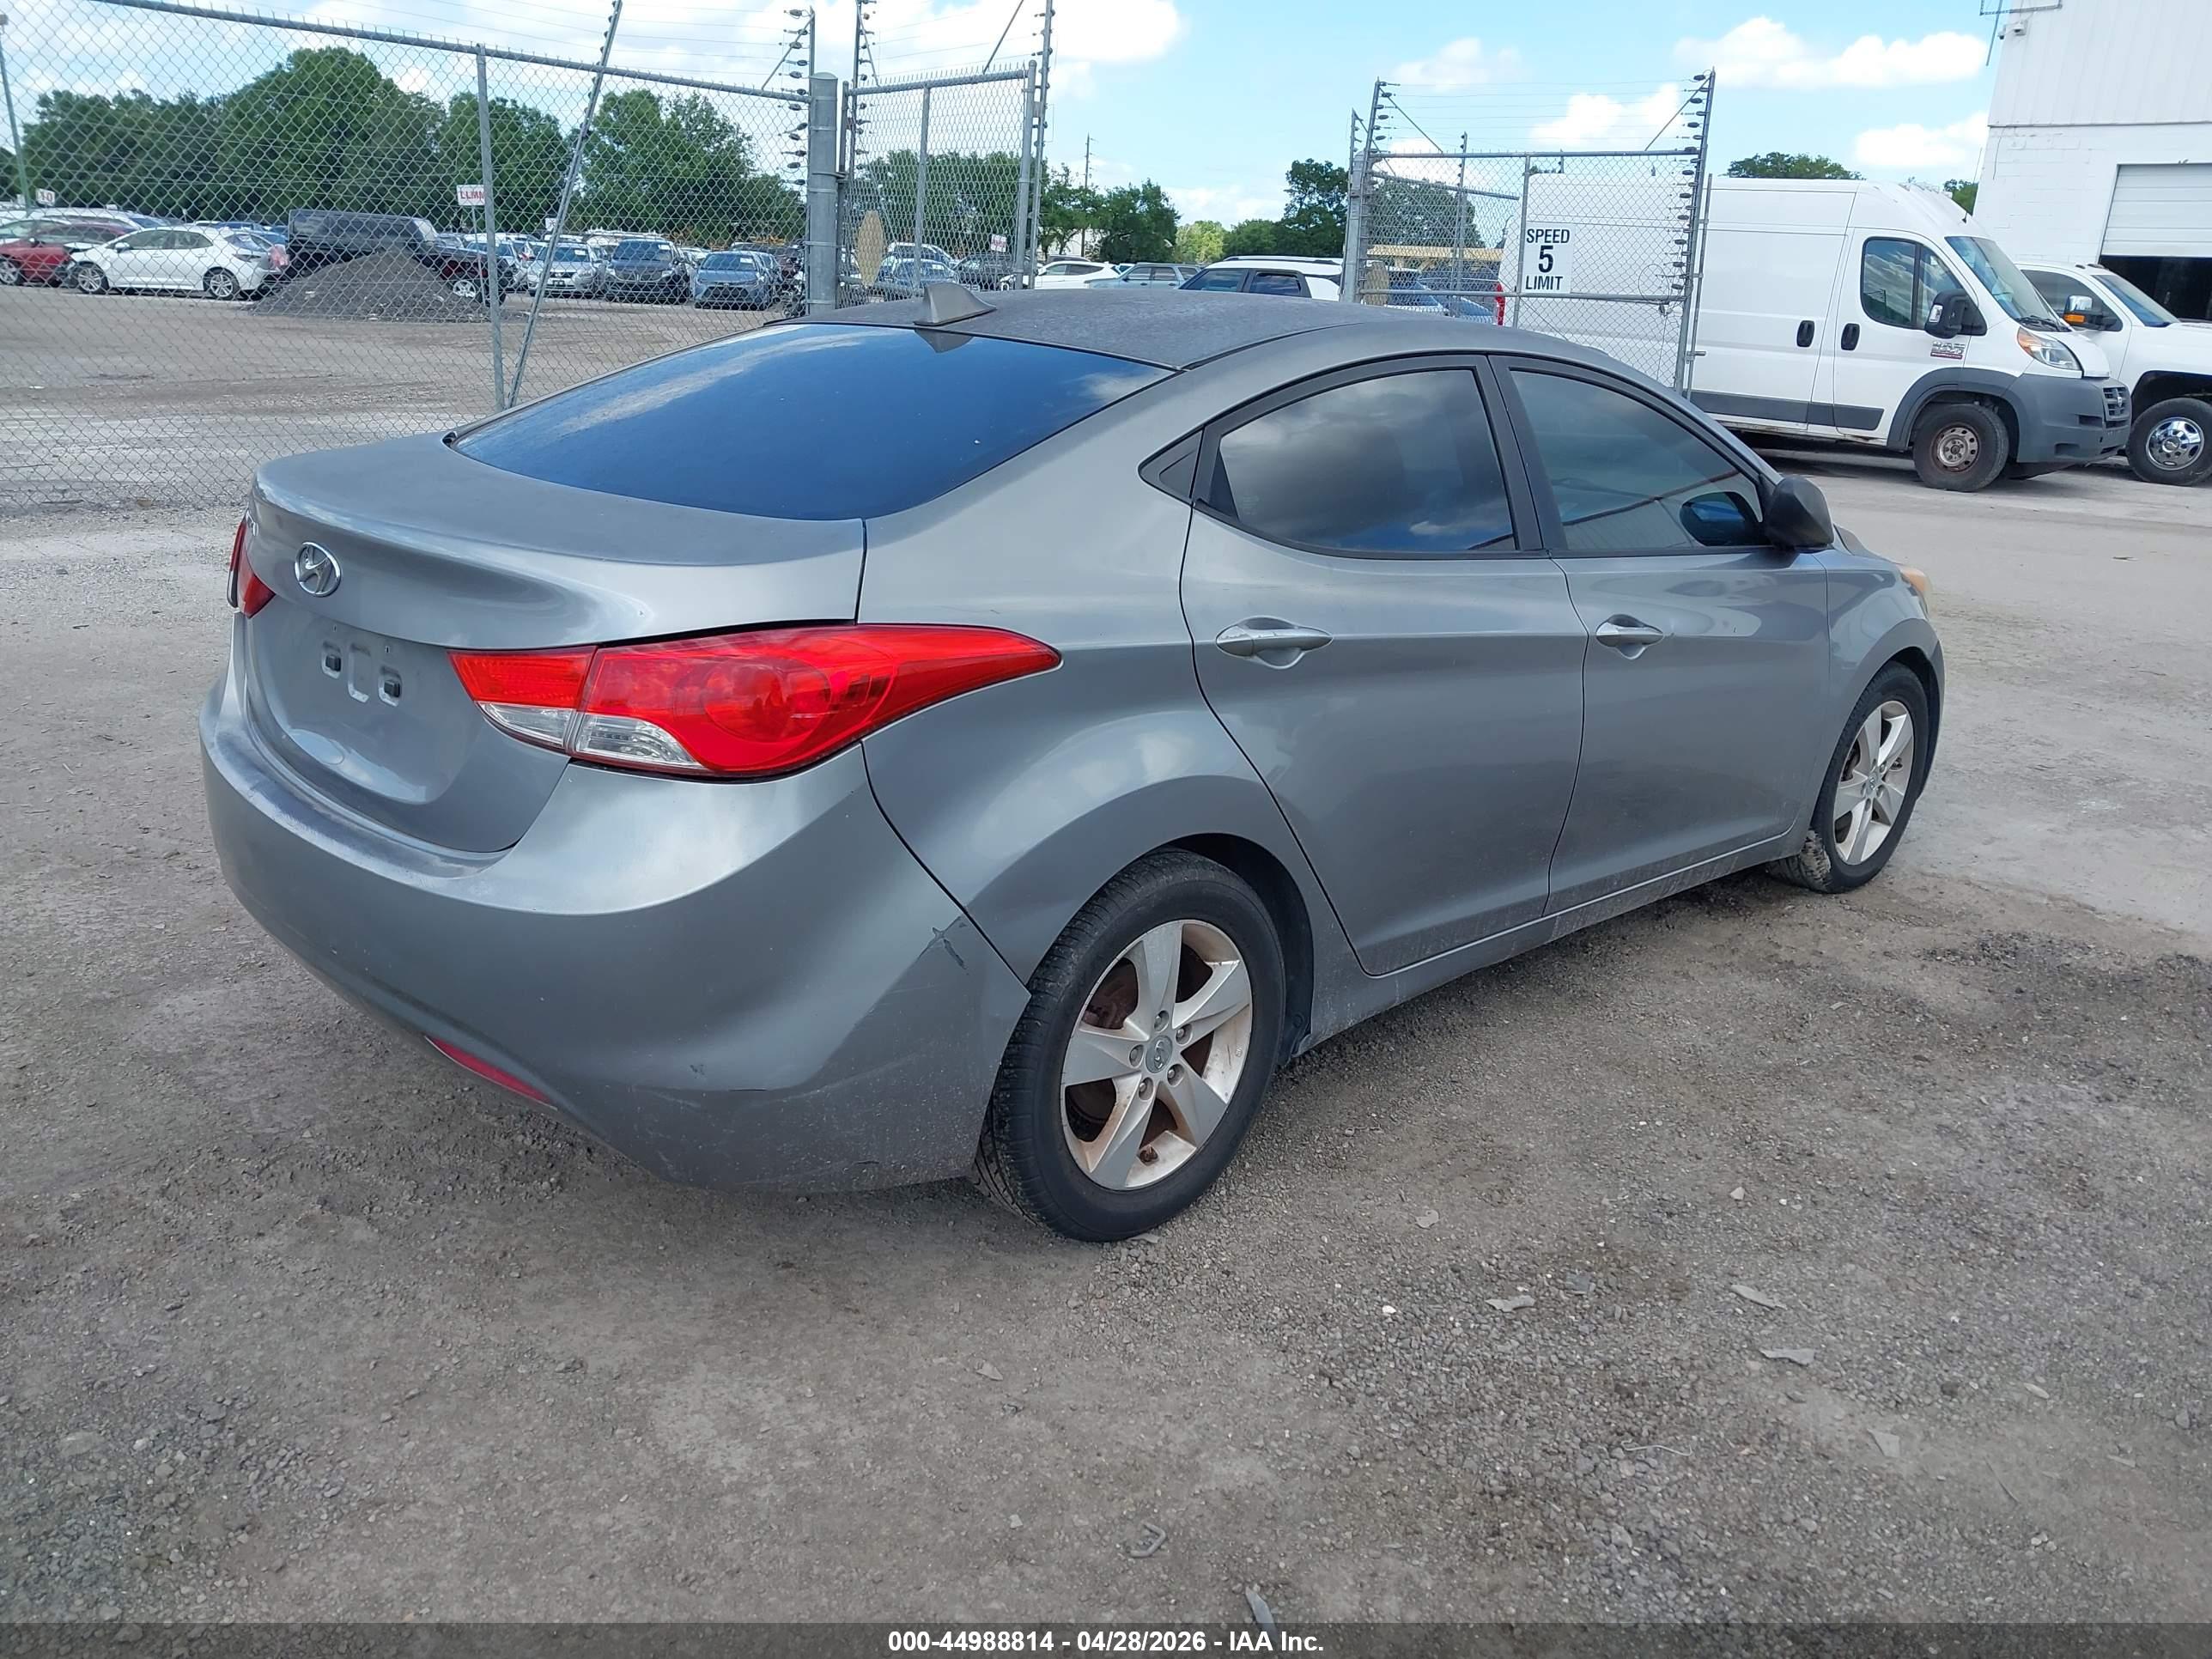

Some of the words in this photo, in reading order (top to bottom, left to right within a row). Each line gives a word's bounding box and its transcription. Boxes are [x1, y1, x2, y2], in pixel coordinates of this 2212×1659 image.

[1526, 228, 1571, 244] SPEED
[1538, 245, 1554, 273] 5
[1525, 276, 1564, 290] LIMIT
